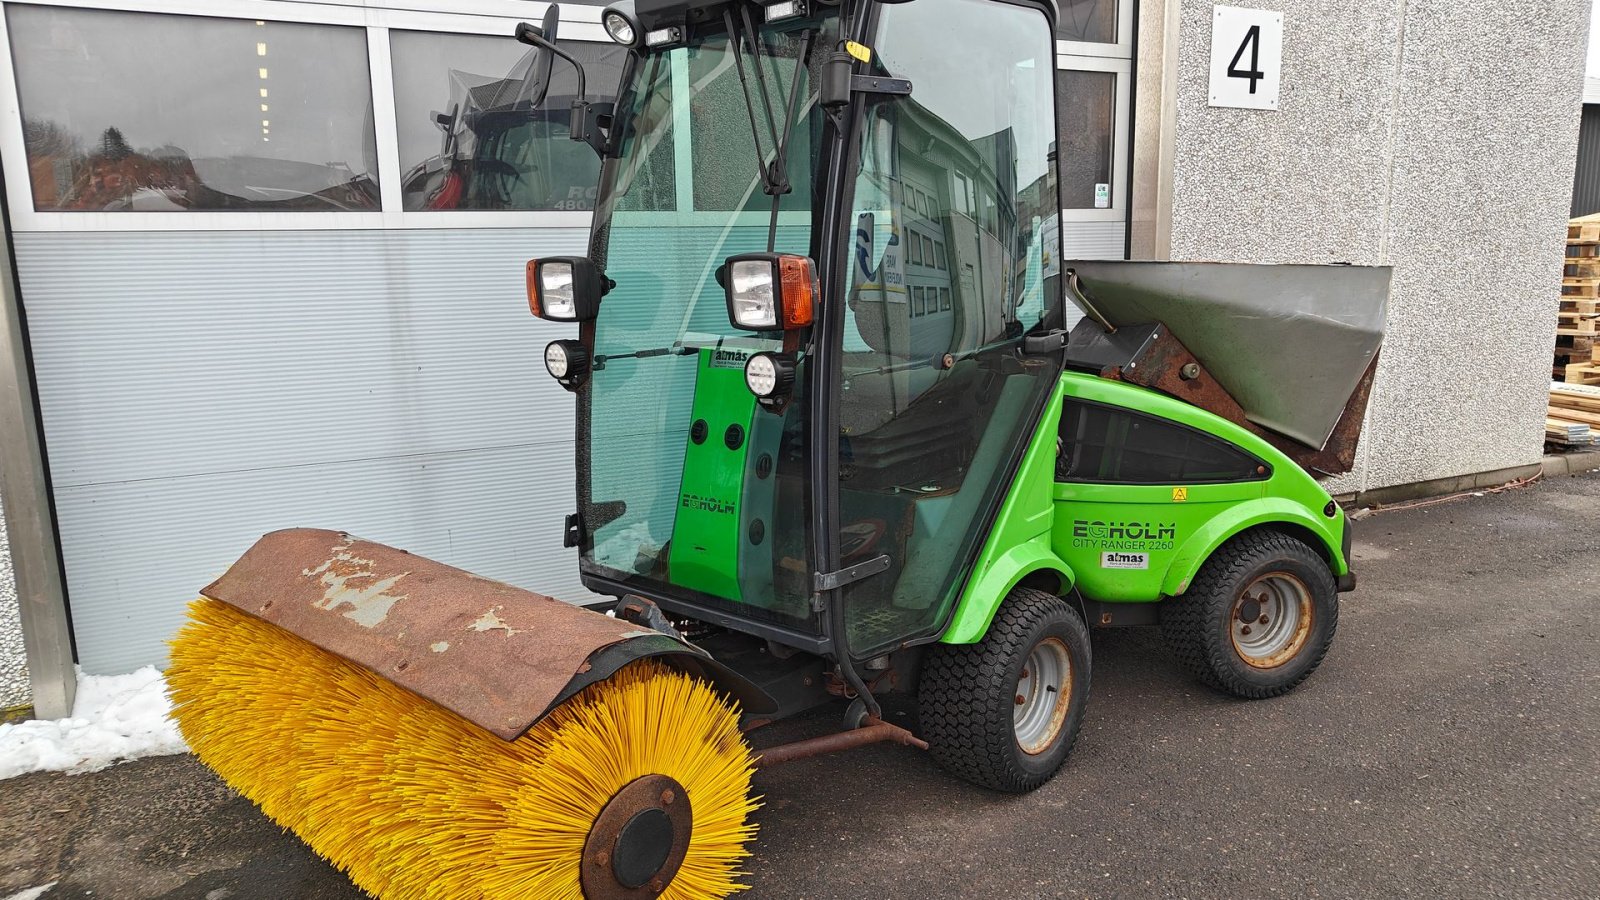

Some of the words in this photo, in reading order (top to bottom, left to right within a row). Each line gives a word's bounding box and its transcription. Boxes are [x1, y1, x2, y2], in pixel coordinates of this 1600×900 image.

[1227, 25, 1264, 94] 4
[682, 494, 736, 515] EGHOLM
[1073, 520, 1176, 540] EGHOLM
[1072, 538, 1098, 549] CITY
[1101, 540, 1146, 550] RANGER
[1148, 541, 1174, 550] 2260
